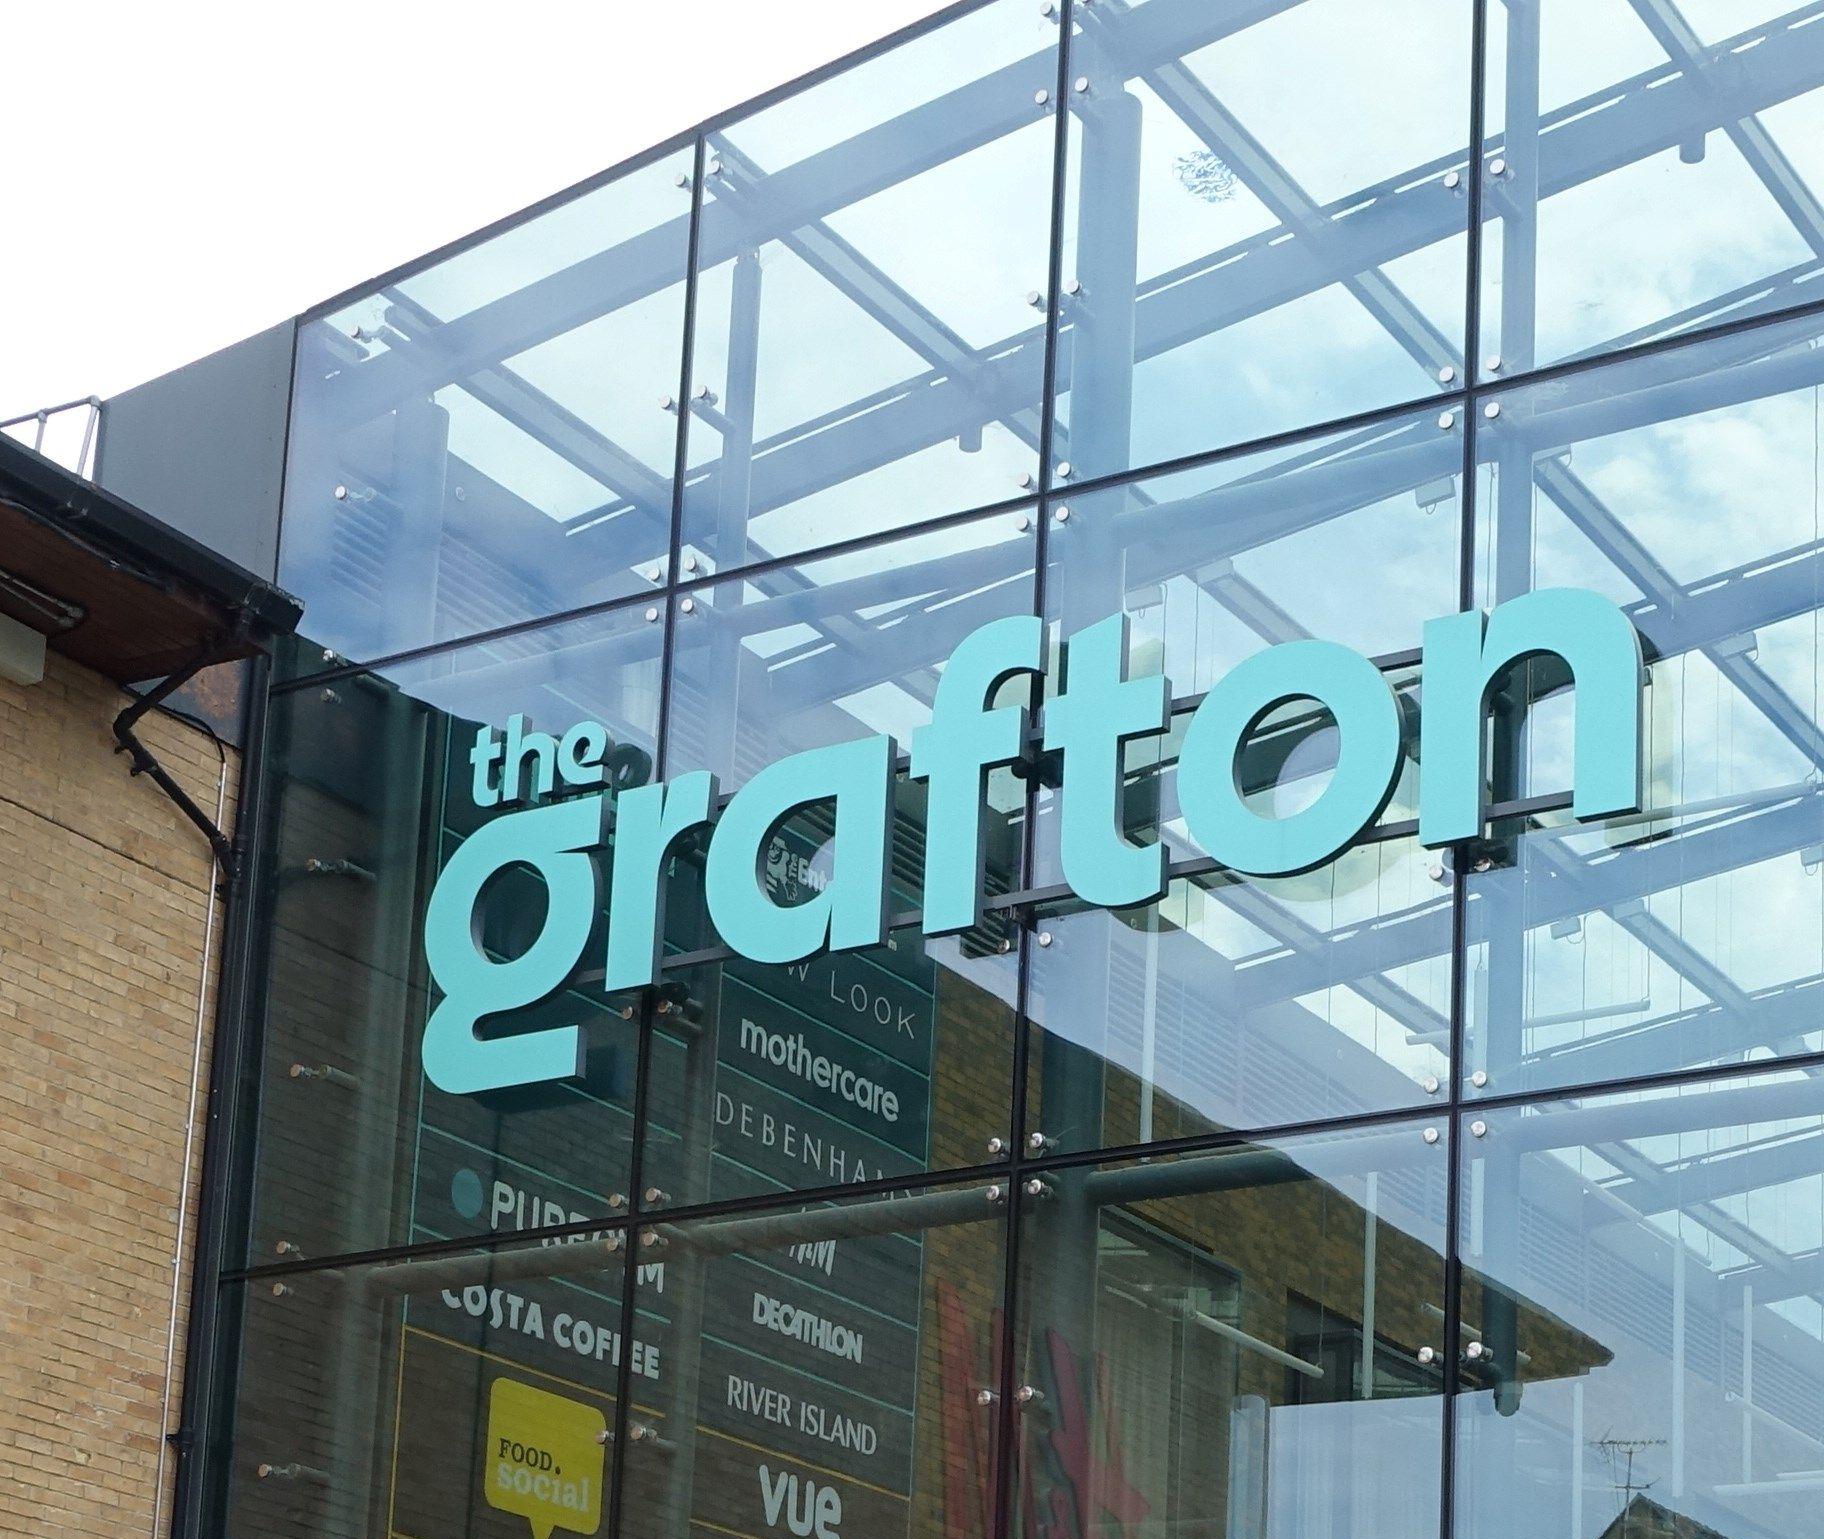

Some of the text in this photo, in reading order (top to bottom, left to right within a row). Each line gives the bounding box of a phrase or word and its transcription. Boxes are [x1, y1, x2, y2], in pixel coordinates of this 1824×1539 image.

[470, 711, 611, 808] the
[422, 587, 1650, 1095] grafton
[831, 970, 916, 1039] LOOK
[740, 1018, 899, 1122] mothercare
[716, 1091, 912, 1200] DEBENHA
[753, 1292, 864, 1364] DECATHLON
[727, 1374, 877, 1455] RIVER ISLAND
[496, 1462, 592, 1514] social
[499, 1438, 562, 1476] FOOD.
